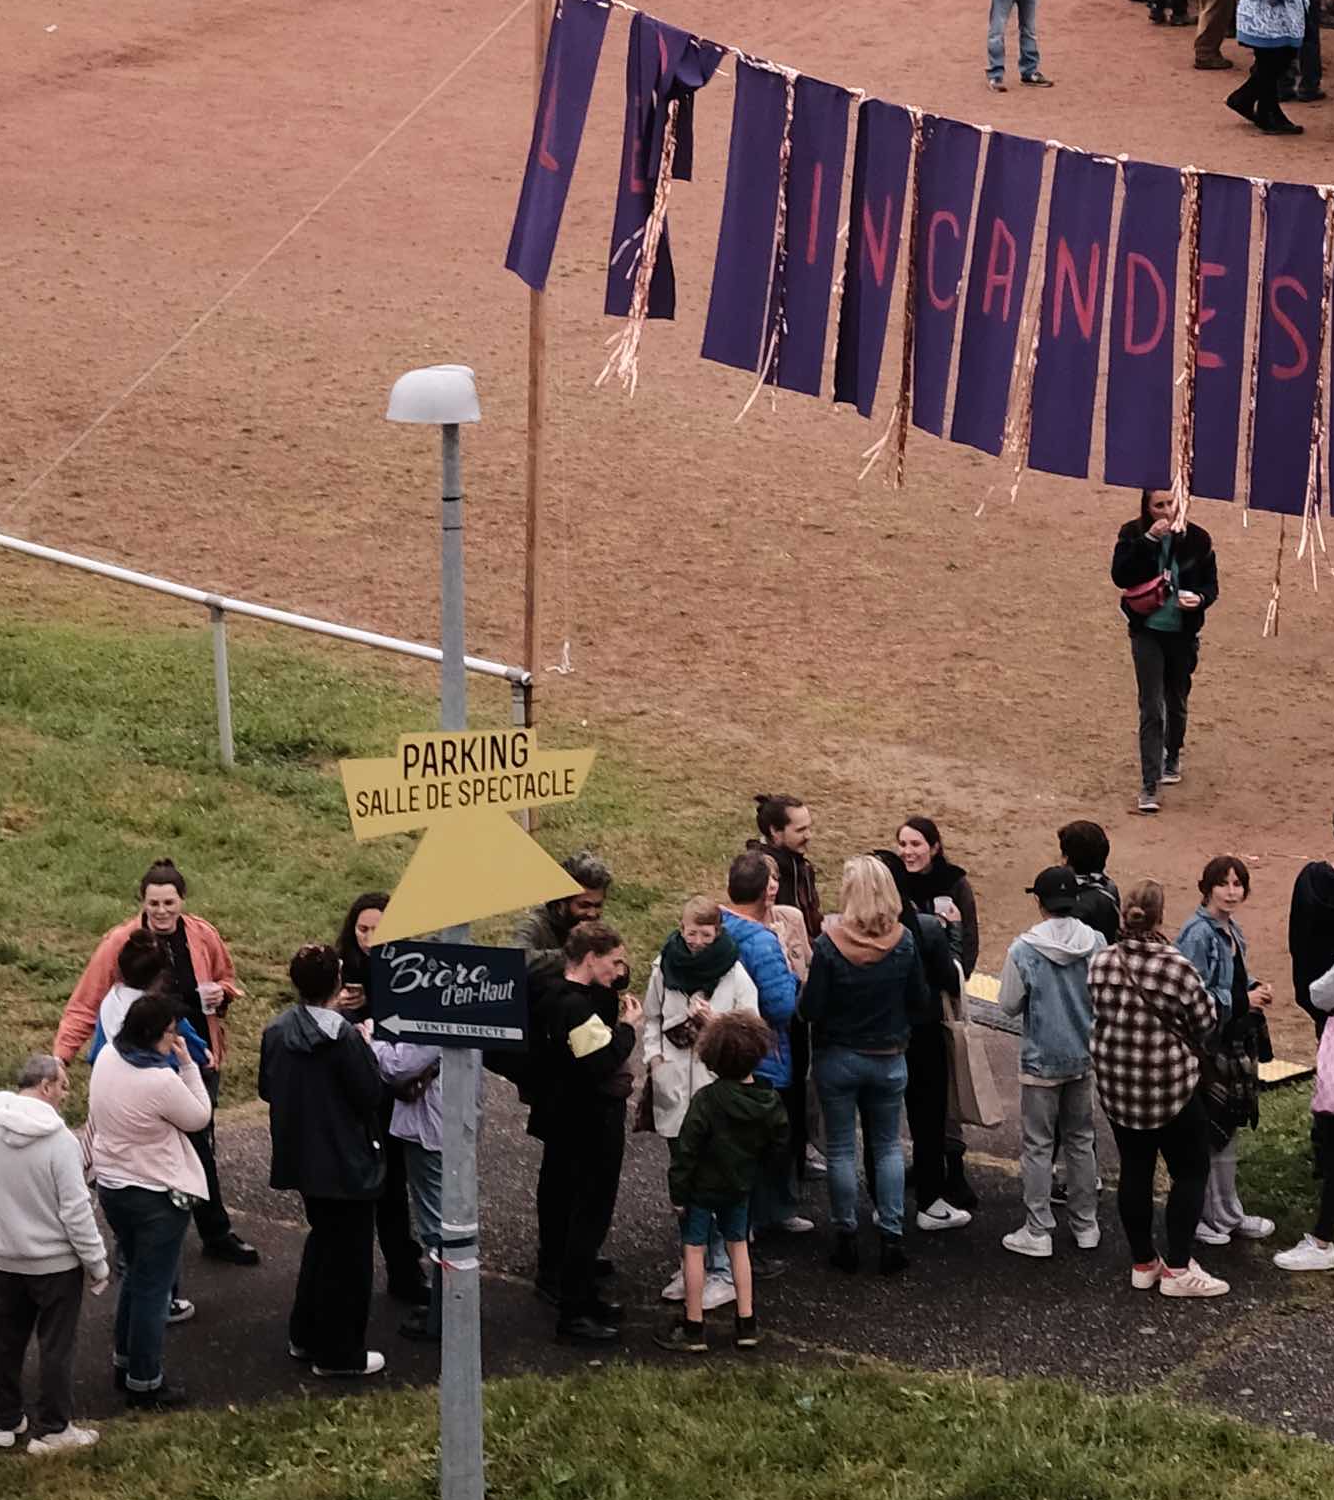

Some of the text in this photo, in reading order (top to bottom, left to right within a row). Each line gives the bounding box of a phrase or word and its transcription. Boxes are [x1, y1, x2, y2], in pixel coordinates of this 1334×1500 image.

[403, 732, 529, 780] PARKING
[355, 769, 576, 818] SALLE DE SPECTACLE
[380, 943, 396, 960] La
[390, 952, 491, 993] Bière
[441, 979, 515, 1007] d'en-Haut
[416, 1021, 507, 1039] VENTE DIRECTE
